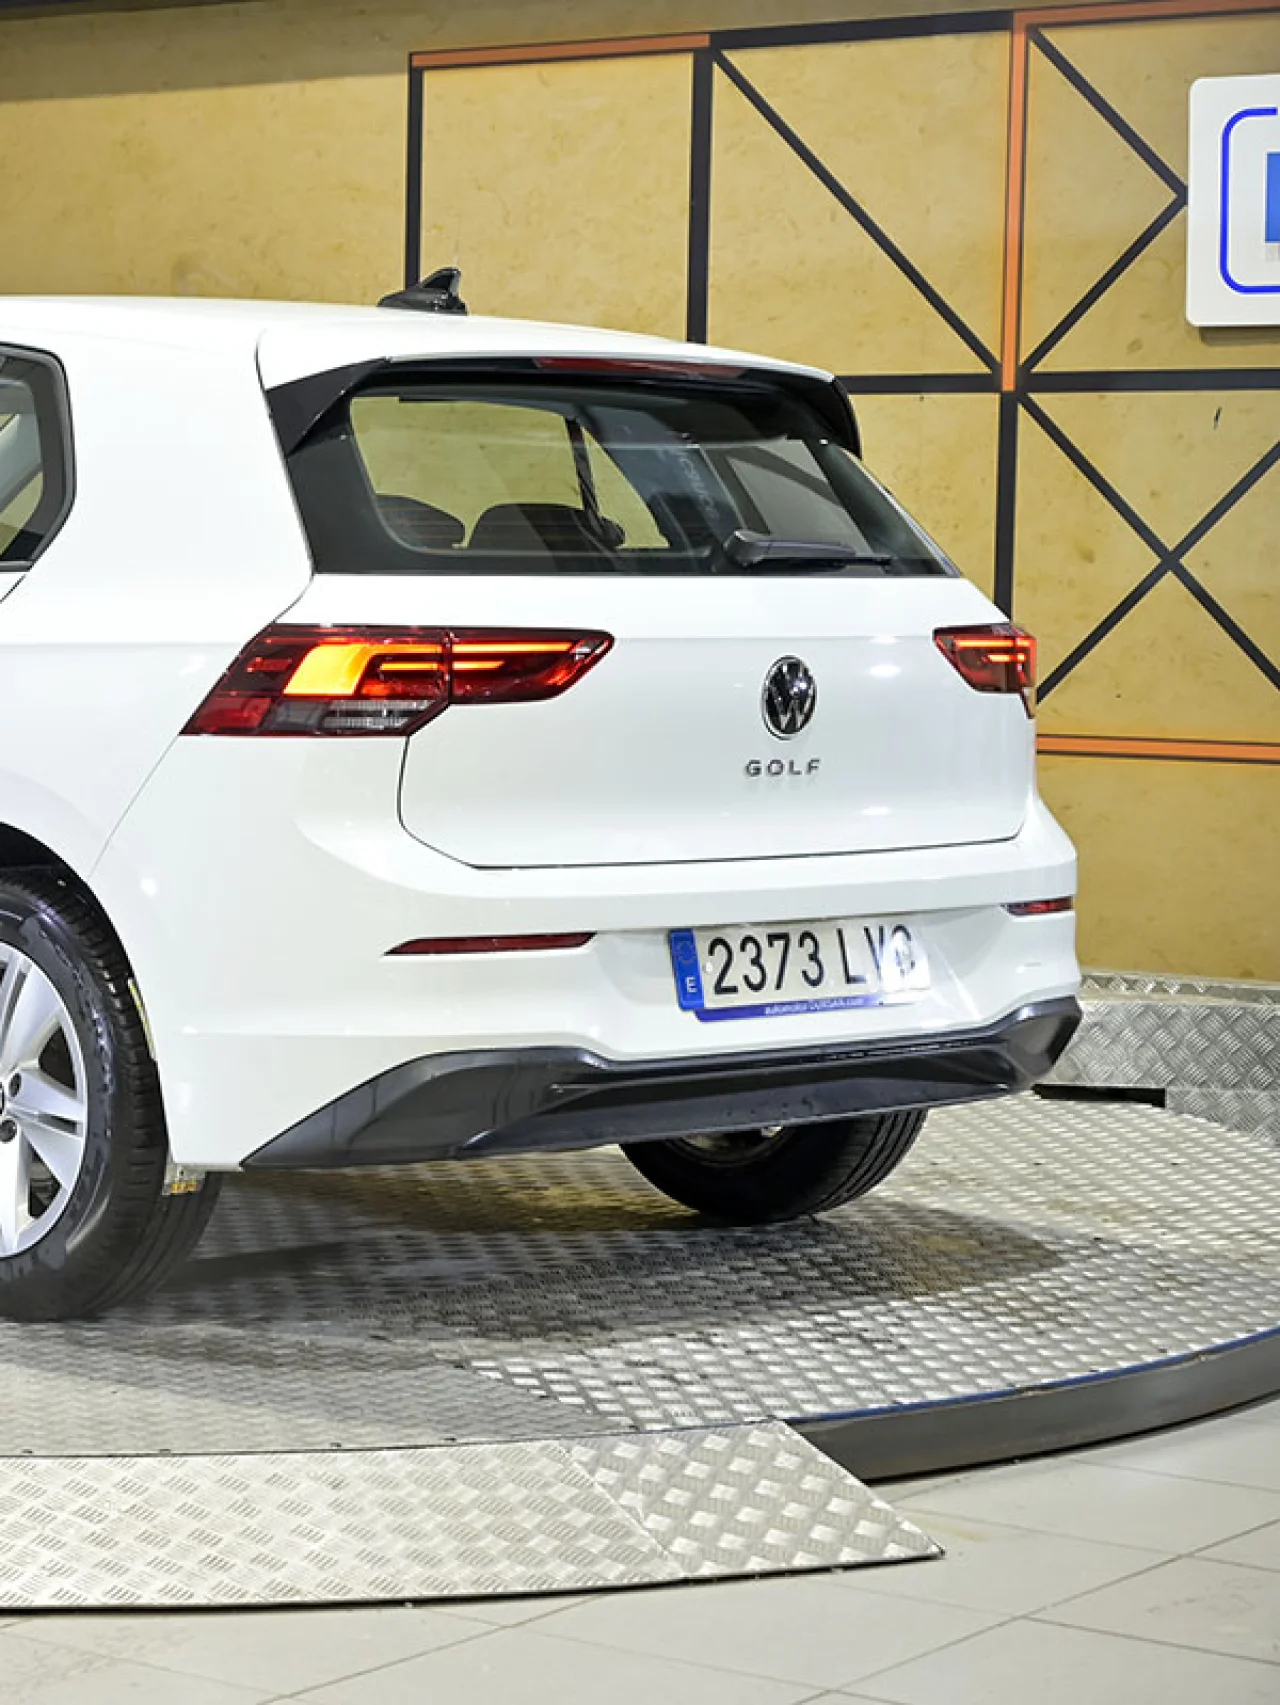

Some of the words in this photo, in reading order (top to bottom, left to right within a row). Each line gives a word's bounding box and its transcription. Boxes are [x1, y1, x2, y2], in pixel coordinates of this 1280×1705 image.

[746, 758, 821, 777] GOLF
[708, 930, 826, 995] 2373
[686, 976, 697, 993] E
